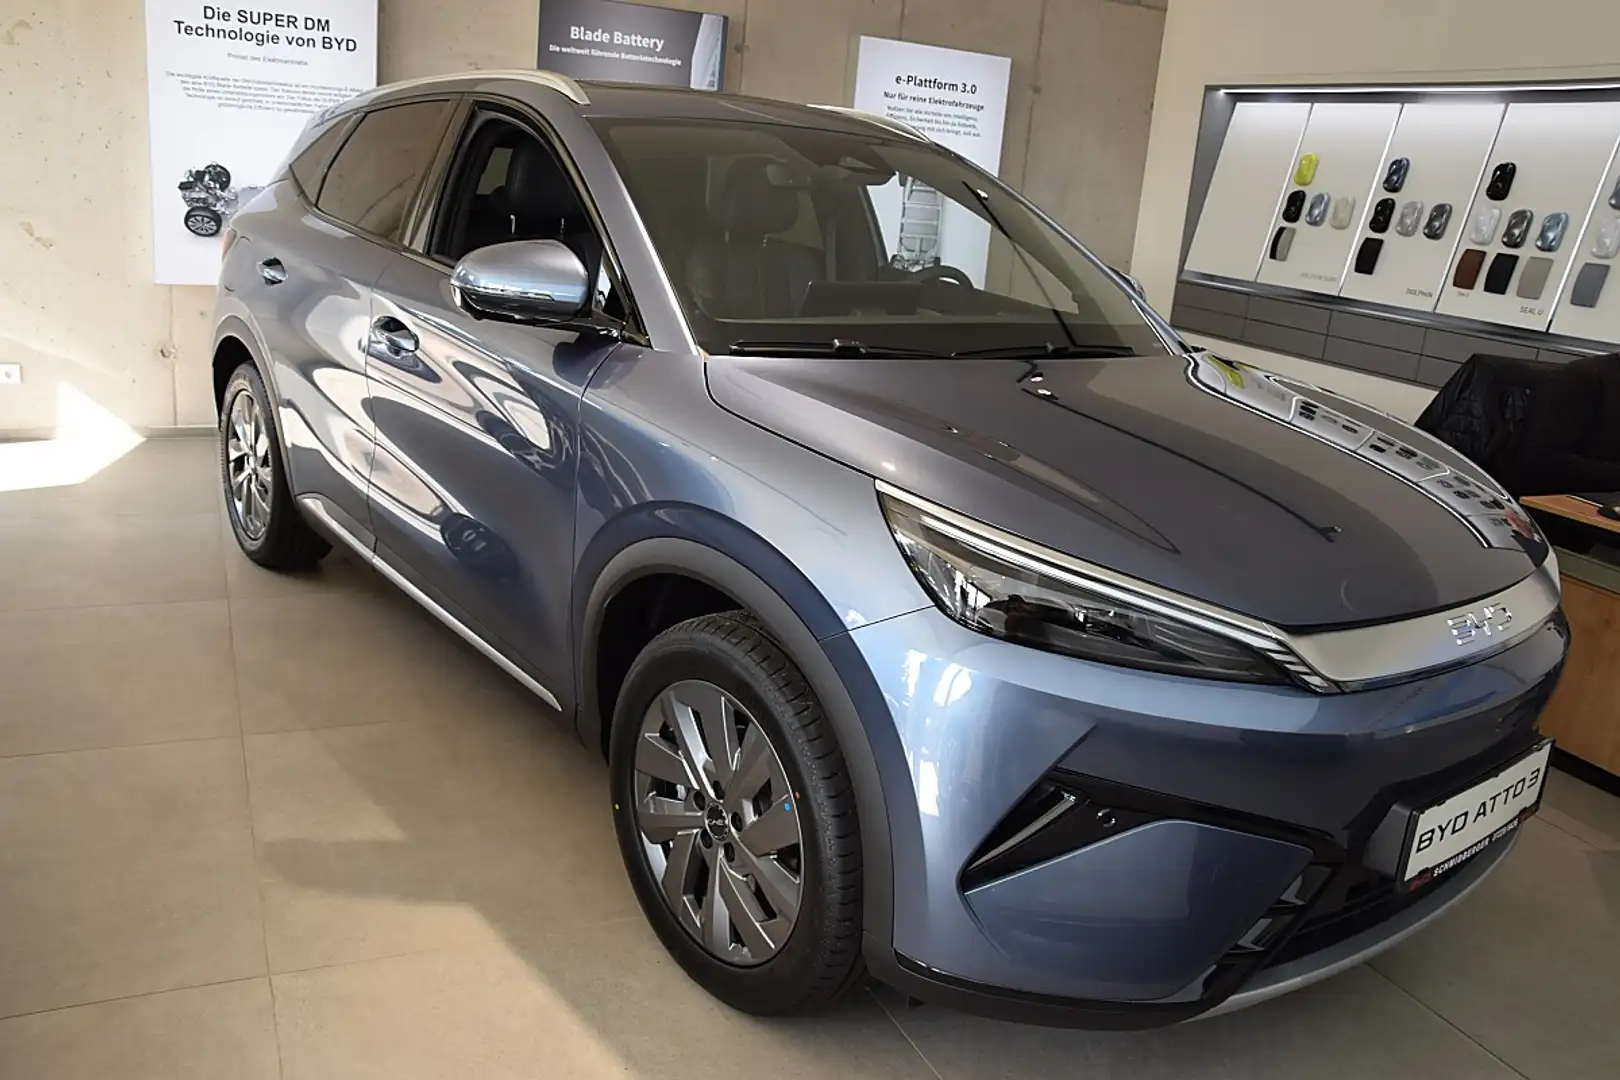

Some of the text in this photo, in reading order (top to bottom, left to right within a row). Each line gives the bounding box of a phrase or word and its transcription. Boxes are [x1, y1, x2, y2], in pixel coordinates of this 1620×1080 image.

[203, 5, 330, 33] Die SUPER DM
[173, 19, 358, 53] Technologie von BYD
[570, 25, 665, 52] Blade Battery
[549, 44, 682, 67] Die weltweit führende Batterietechnologie
[895, 74, 978, 95] e-Plattform 3.0
[883, 91, 985, 112] Nur für reine Elektrofahrzeuge
[1519, 305, 1536, 316] SEAL
[1447, 603, 1512, 646] BYD
[1415, 811, 1469, 854] BYD
[1472, 783, 1525, 824] ATTO
[1525, 767, 1541, 791] 3
